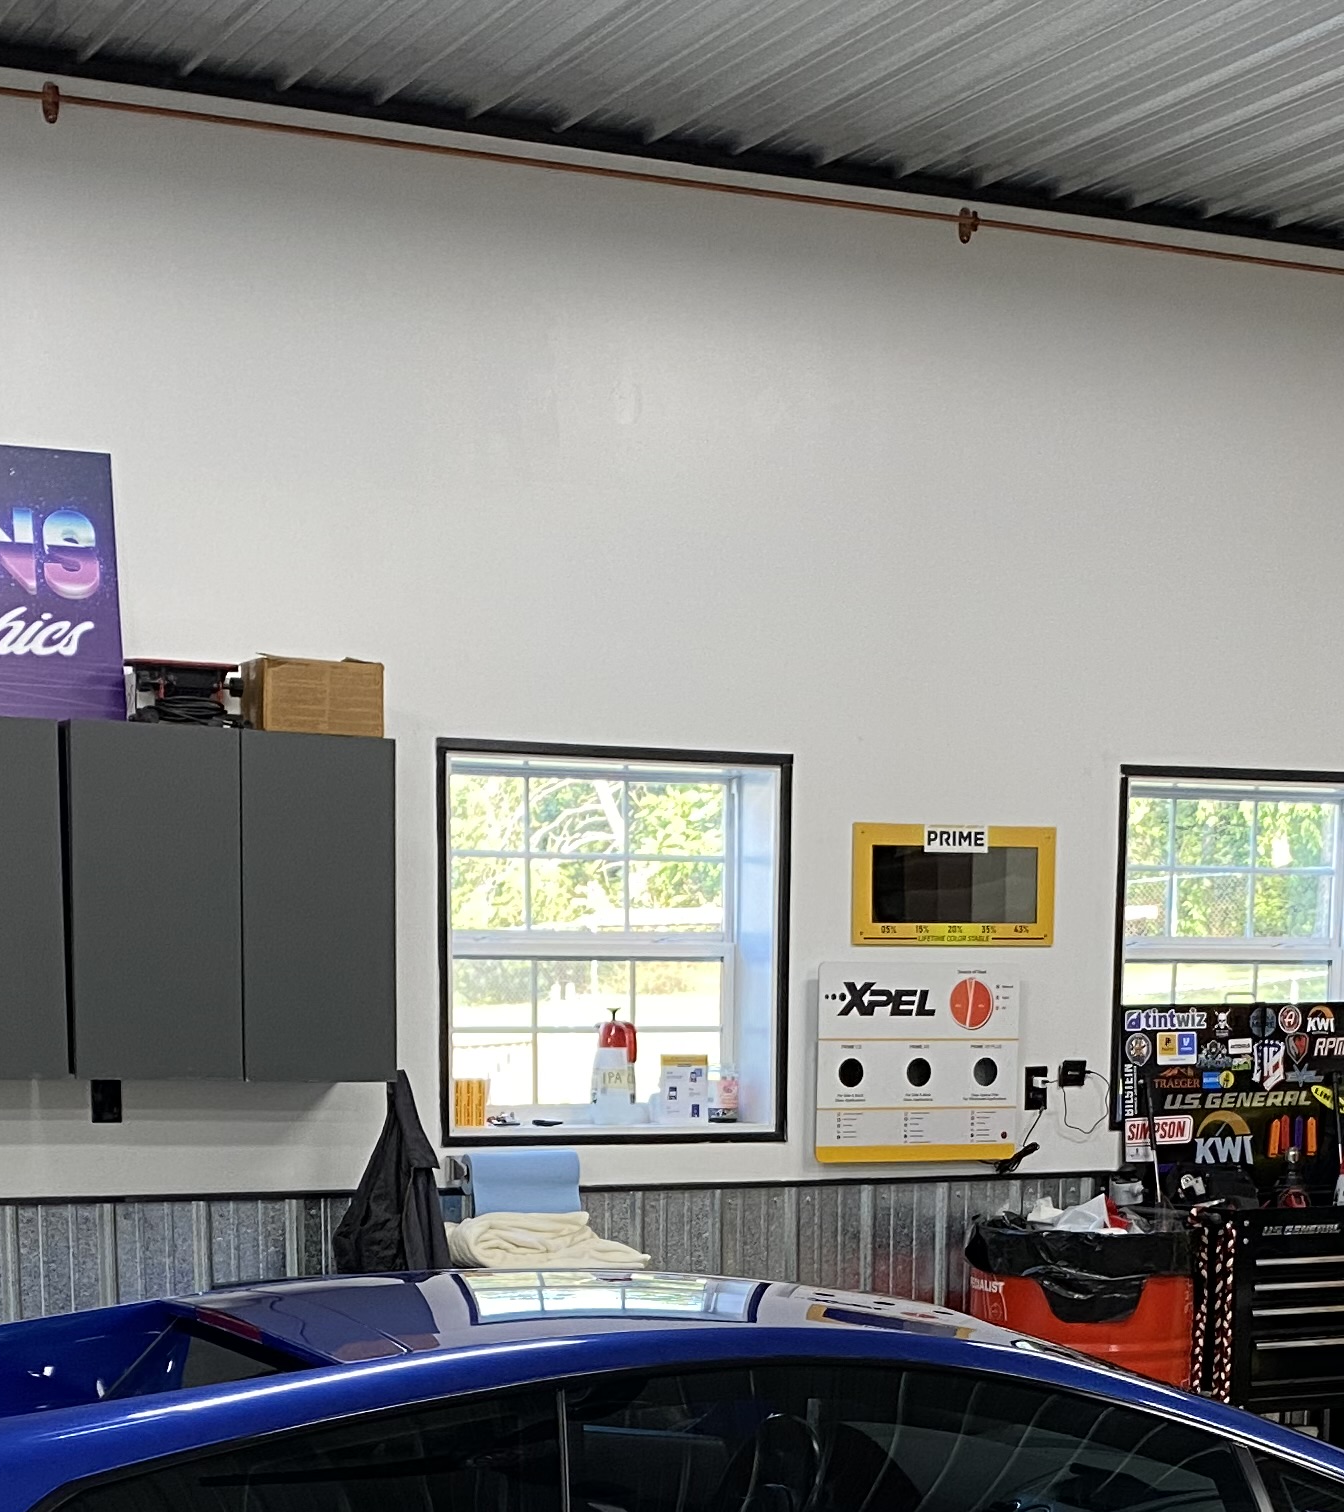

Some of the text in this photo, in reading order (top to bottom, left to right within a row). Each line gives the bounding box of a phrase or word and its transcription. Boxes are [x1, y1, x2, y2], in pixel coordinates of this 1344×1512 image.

[927, 830, 985, 847] PRIME
[837, 981, 936, 1017] XPEL
[1144, 1008, 1206, 1028] tintwiz
[602, 1071, 623, 1085] IPA
[1153, 1078, 1200, 1089] TRAEGER
[1124, 1063, 1134, 1117] BILSTEIN
[1204, 1091, 1312, 1109] GENERAL
[1127, 1121, 1187, 1141] SIMPSON
